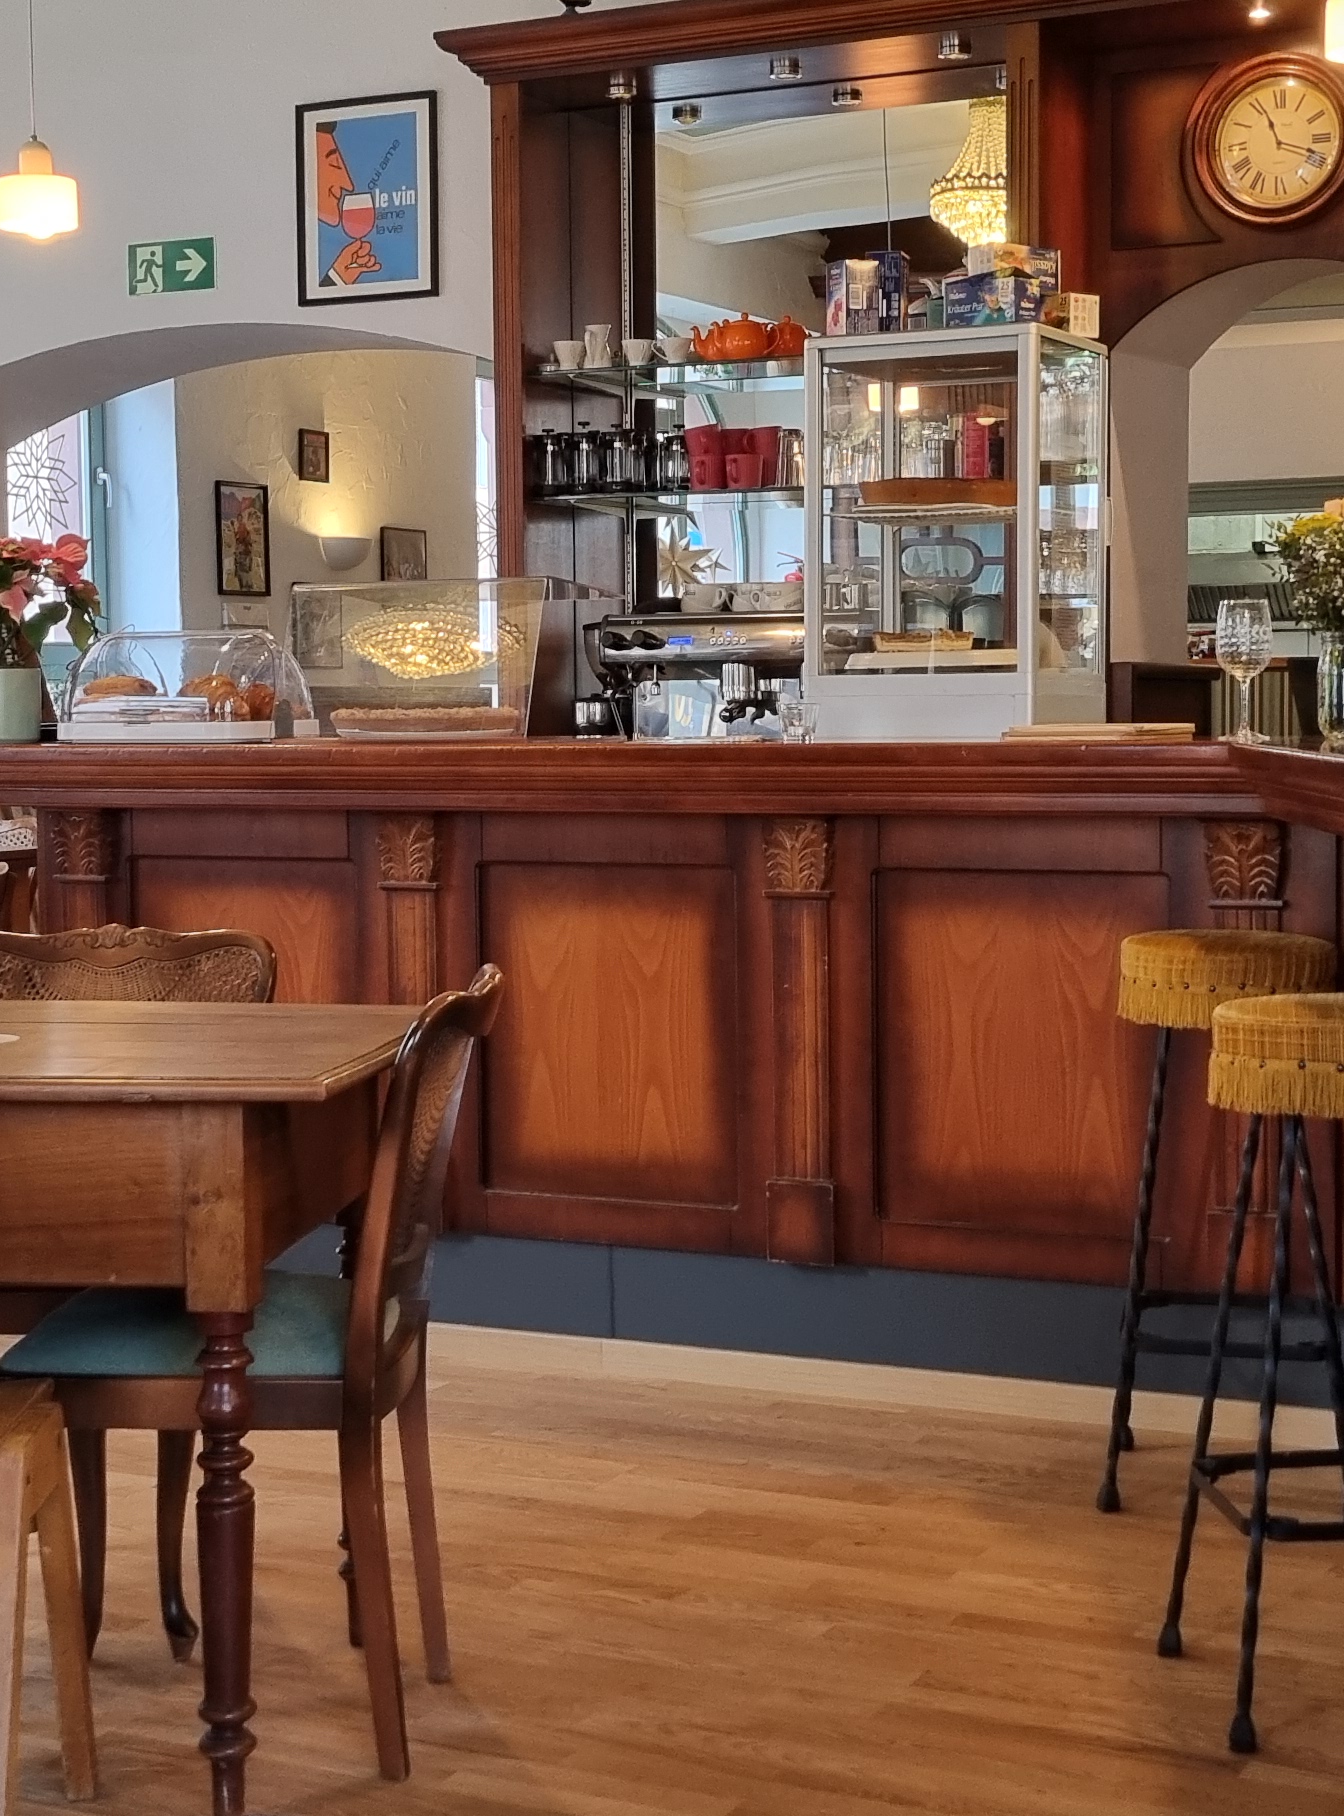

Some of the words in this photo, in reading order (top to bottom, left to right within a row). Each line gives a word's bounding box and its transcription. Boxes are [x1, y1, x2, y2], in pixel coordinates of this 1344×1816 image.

[367, 168, 382, 190] qui
[379, 139, 401, 171] aime
[375, 188, 388, 208] le
[392, 185, 416, 206] vin
[376, 208, 405, 220] aime
[376, 223, 385, 235] la
[387, 222, 403, 234] vie
[1059, 296, 1067, 306] 25
